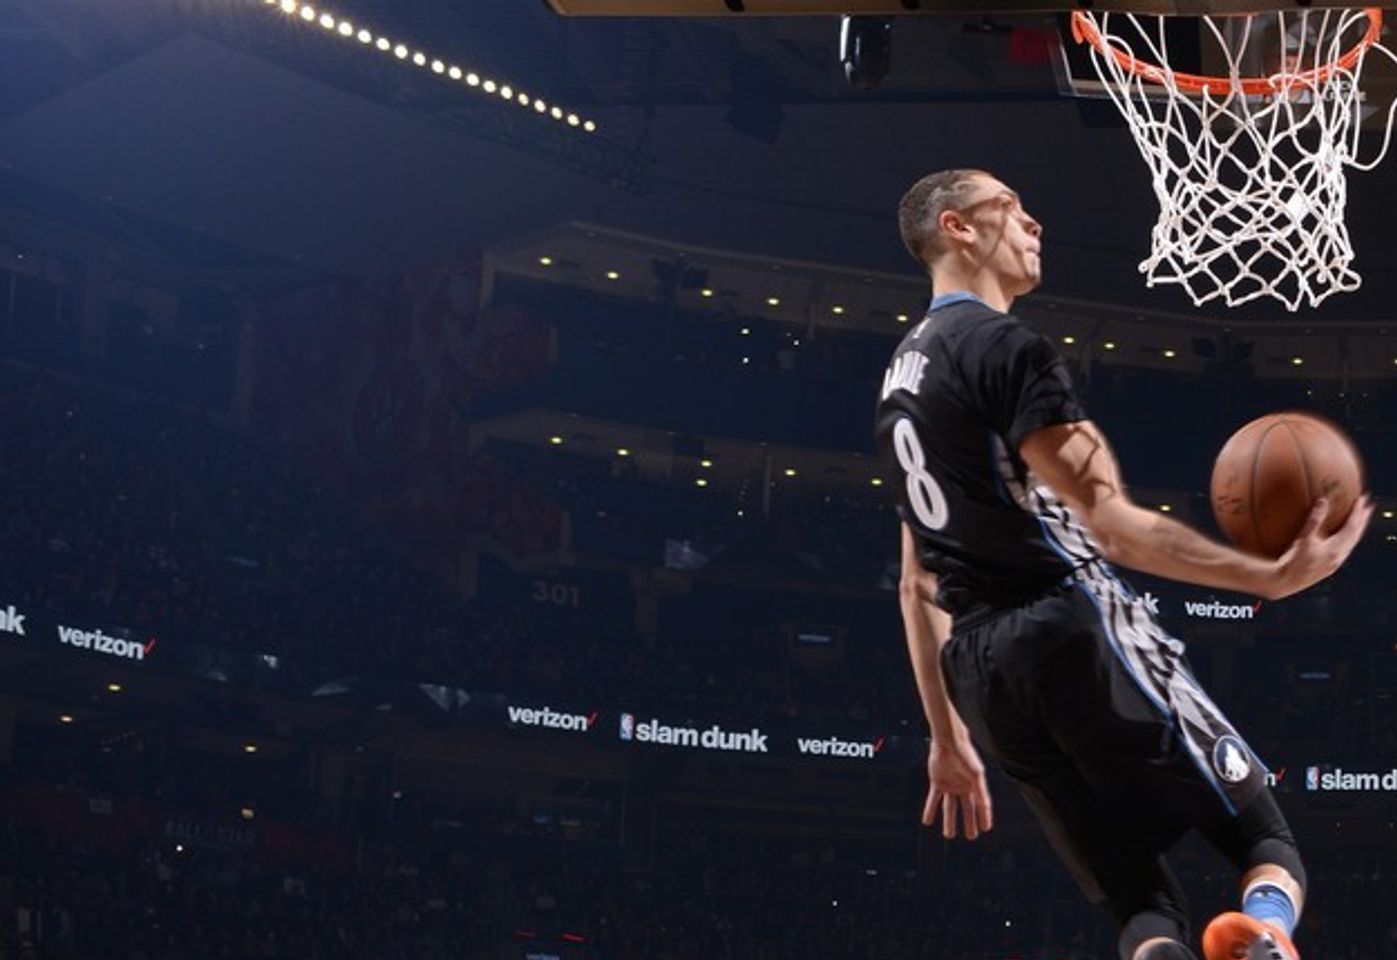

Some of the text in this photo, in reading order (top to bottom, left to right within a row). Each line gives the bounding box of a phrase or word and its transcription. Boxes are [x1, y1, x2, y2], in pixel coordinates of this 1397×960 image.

[893, 417, 949, 530] 8
[1185, 601, 1253, 619] verizon
[58, 625, 145, 660] verizon
[508, 706, 587, 731] verizon
[635, 719, 768, 753] slam dunk
[797, 737, 874, 758] verizon
[1320, 768, 1380, 791] slam
